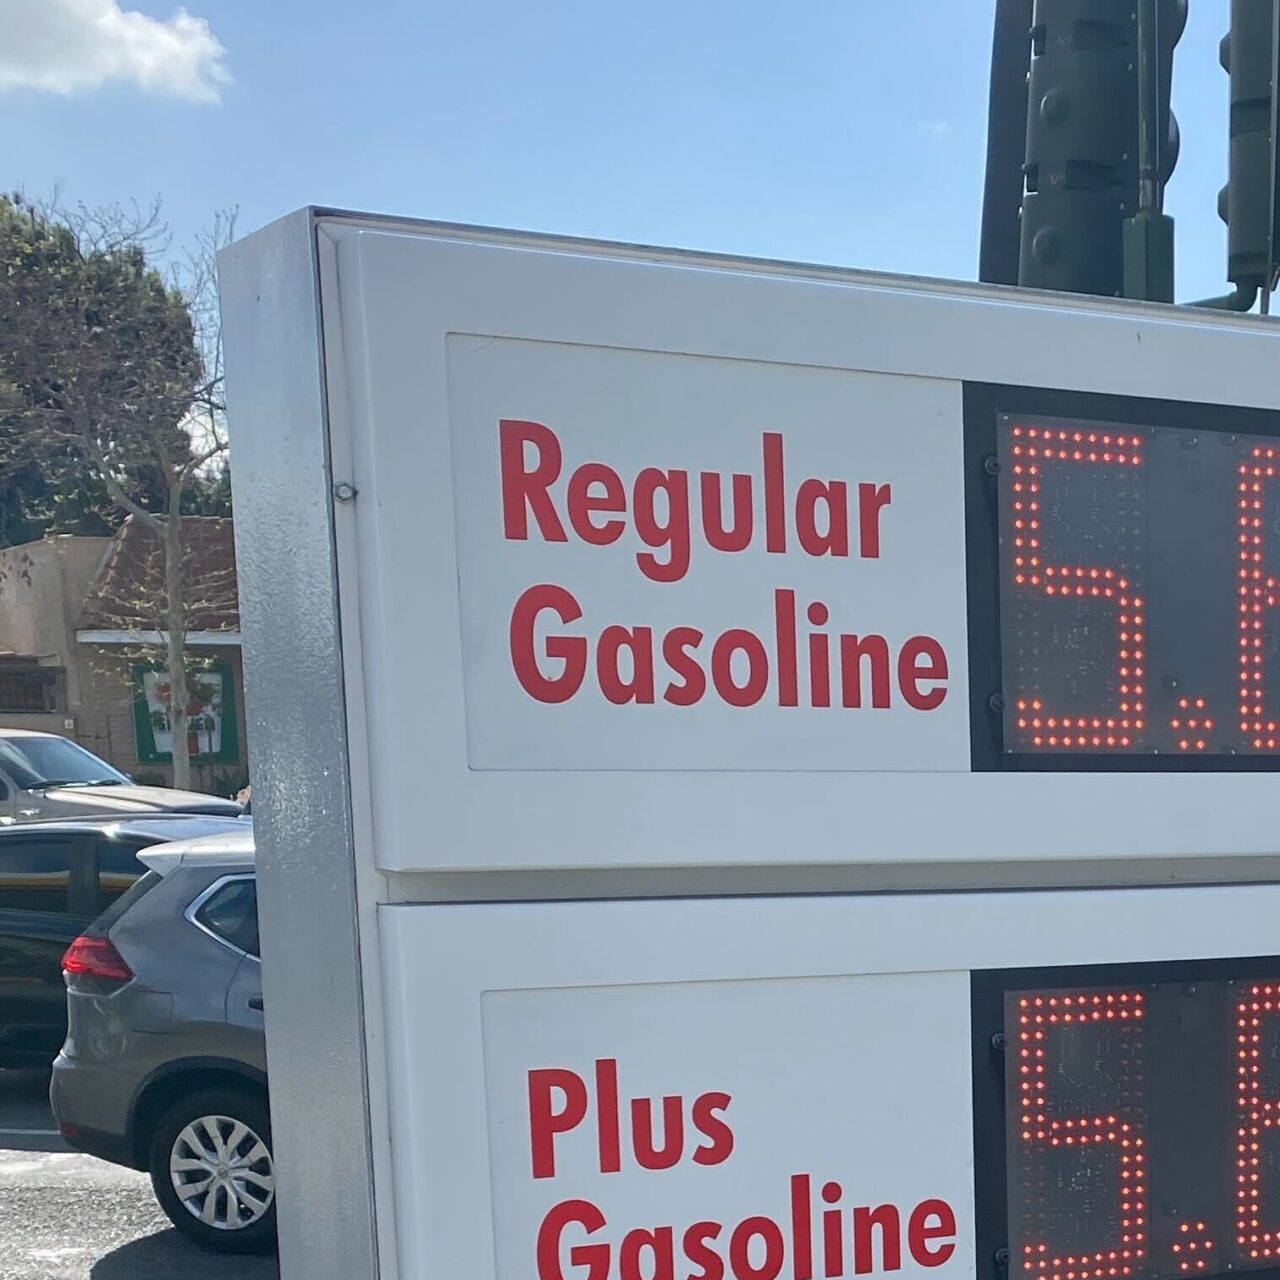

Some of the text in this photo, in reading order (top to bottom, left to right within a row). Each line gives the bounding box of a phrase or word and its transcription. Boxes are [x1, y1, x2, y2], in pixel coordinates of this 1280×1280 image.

[499, 419, 891, 582] Regular
[509, 584, 948, 710] Gasoline
[528, 1058, 734, 1179] Plus
